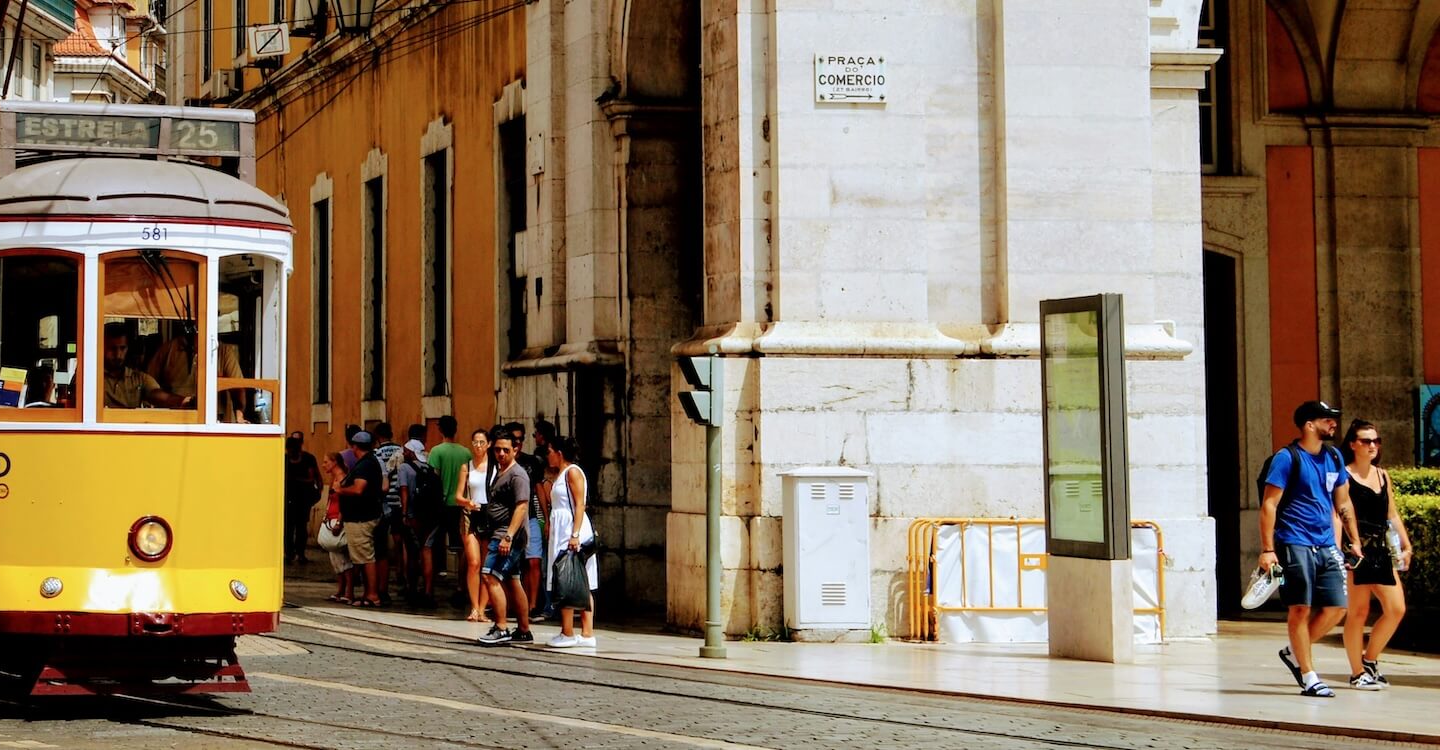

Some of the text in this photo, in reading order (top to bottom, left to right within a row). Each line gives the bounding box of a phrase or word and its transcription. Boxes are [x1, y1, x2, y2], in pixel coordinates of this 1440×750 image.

[828, 56, 875, 67] PRAÇA
[818, 74, 885, 85] COMERCIO
[24, 117, 219, 148] ESTRELA 25
[142, 227, 167, 240] 581
